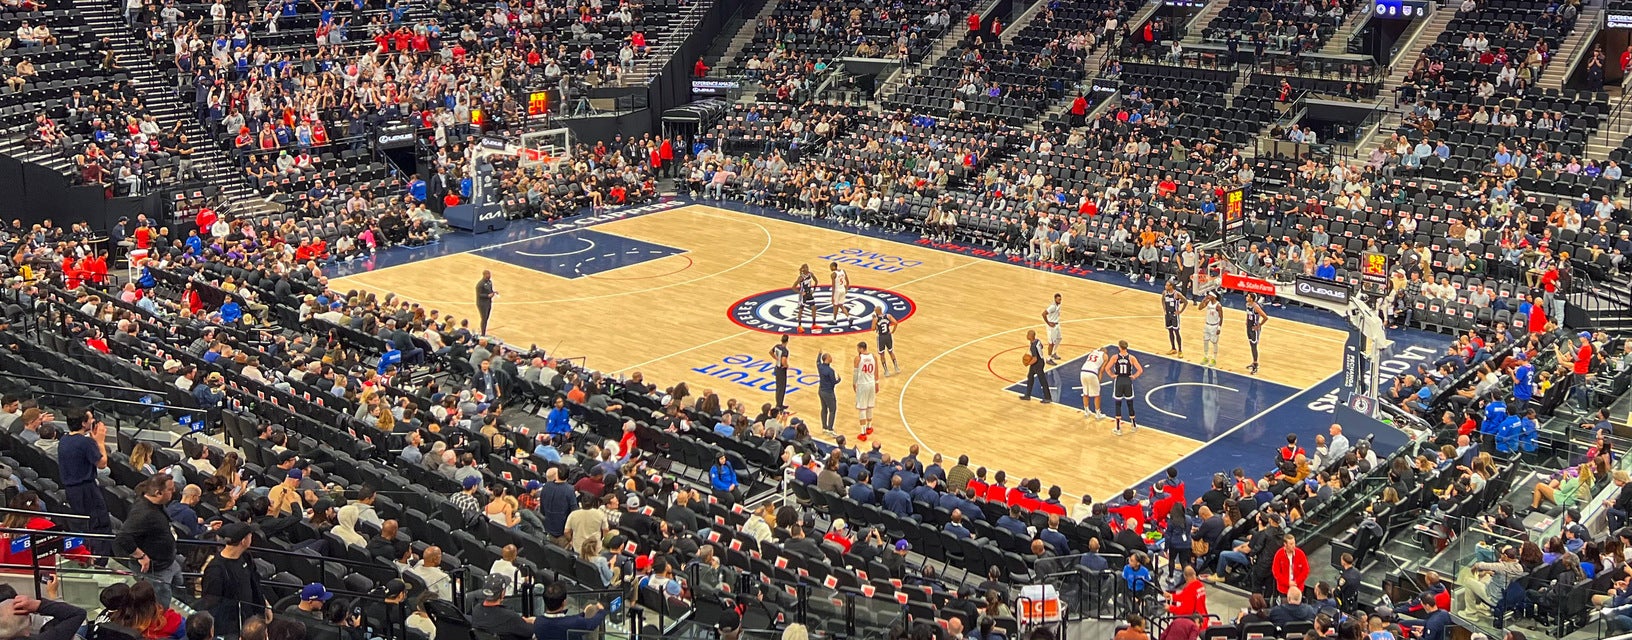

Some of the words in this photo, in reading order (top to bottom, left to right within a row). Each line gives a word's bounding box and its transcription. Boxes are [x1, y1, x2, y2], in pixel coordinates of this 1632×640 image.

[574, 200, 686, 225] CLIPPERS
[1227, 201, 1242, 221] 24
[1370, 254, 1385, 265] 8:32
[1369, 263, 1382, 273] 24
[1259, 284, 1274, 292] Farm
[1311, 287, 1345, 299] LEXUS
[880, 323, 888, 334] 3
[861, 363, 874, 374] 40
[1119, 364, 1128, 374] 11
[1348, 354, 1356, 387] PECHANGA
[23, 540, 31, 548] 8
[65, 541, 72, 549] 8
[1034, 601, 1044, 612] G
